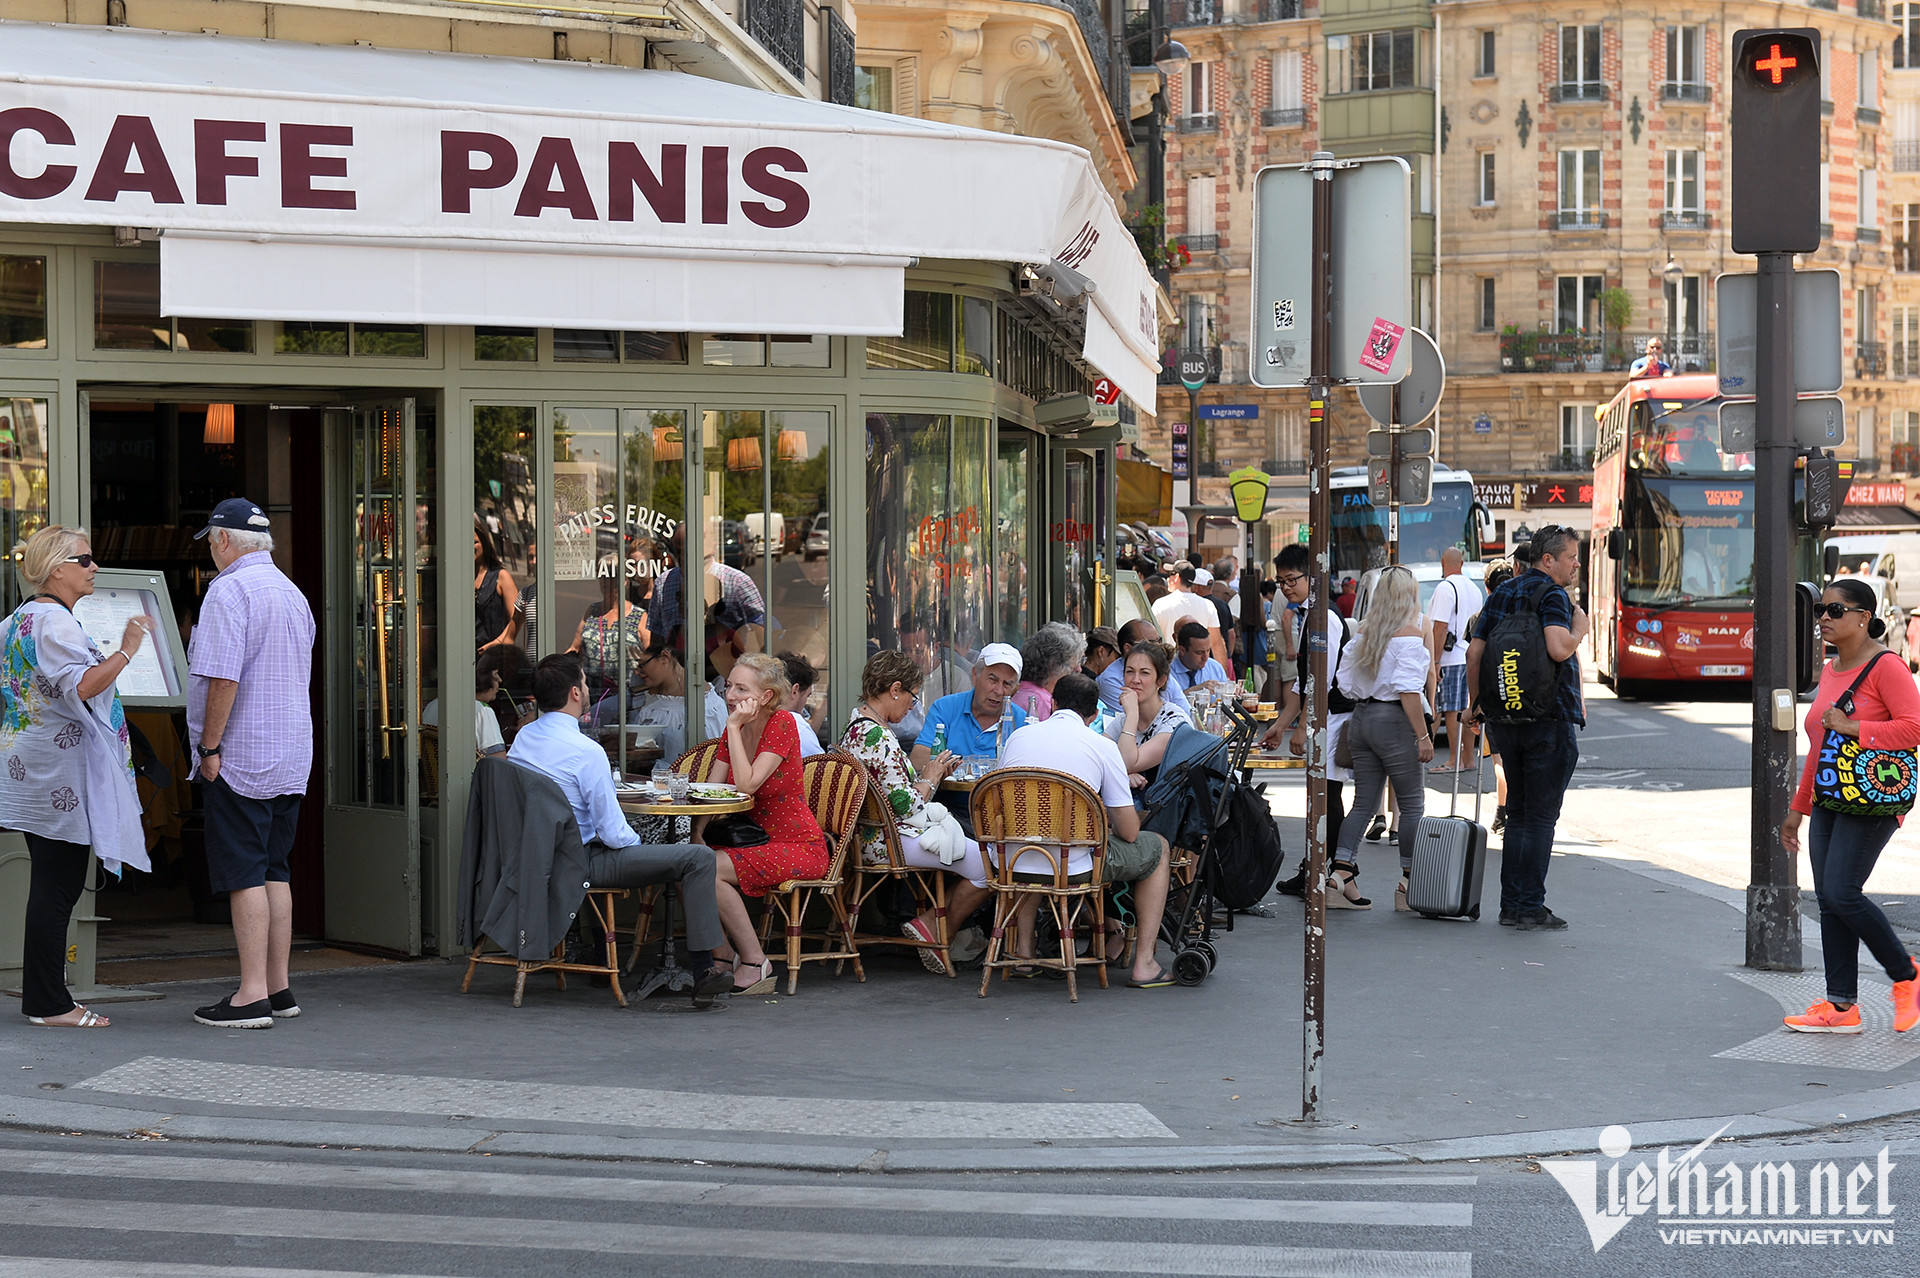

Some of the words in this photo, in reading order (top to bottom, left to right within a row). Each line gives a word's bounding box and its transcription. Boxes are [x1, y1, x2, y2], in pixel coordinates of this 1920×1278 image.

[0, 107, 357, 210] CAFE
[440, 131, 811, 229] PANIS
[1182, 362, 1205, 374] BUS
[1211, 408, 1245, 417] Lagrange
[1174, 425, 1185, 433] 47
[1704, 490, 1744, 499] TICKETS
[1849, 485, 1875, 503] CHEZ
[1876, 485, 1905, 503] WANG
[919, 504, 981, 556] APEROL
[1707, 627, 1740, 635] MAN
[1819, 798, 1912, 816] HEIDELBERG
